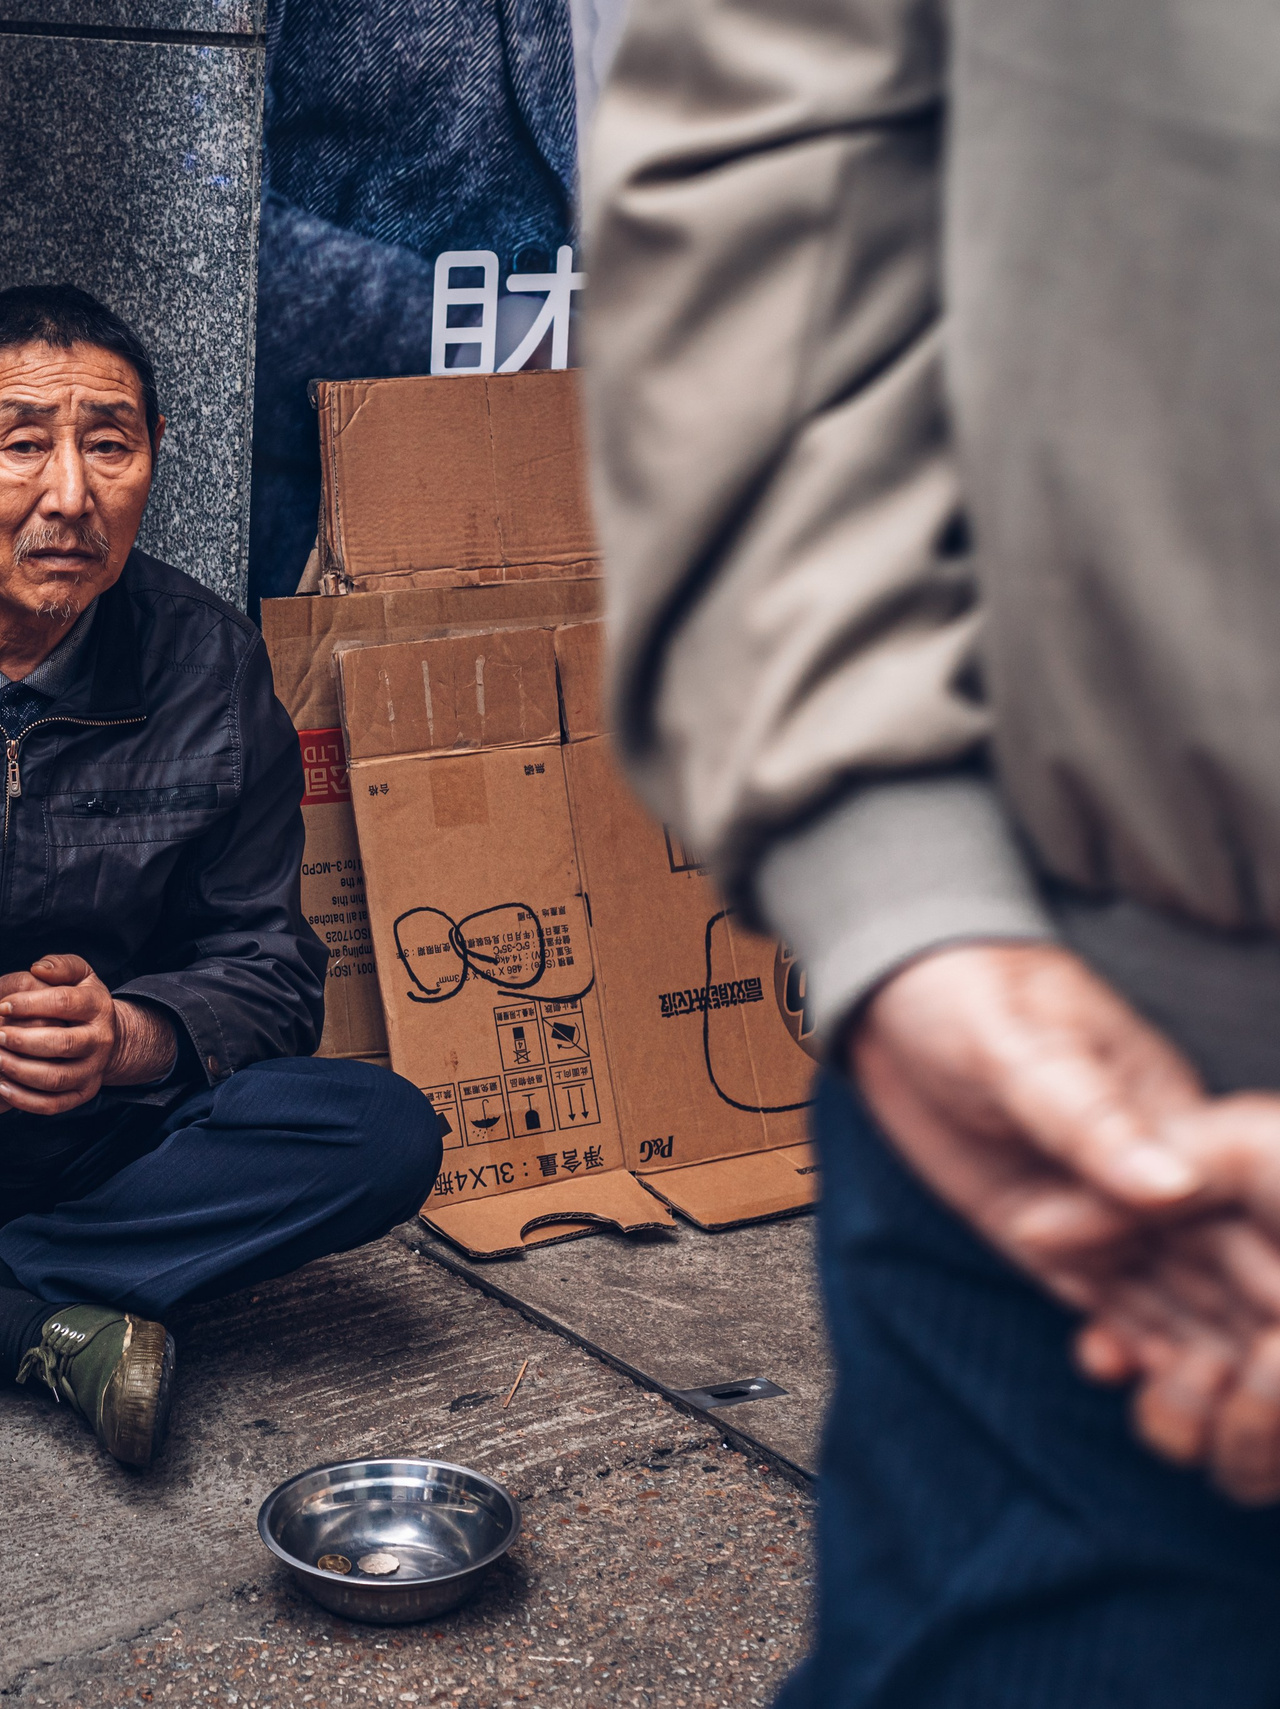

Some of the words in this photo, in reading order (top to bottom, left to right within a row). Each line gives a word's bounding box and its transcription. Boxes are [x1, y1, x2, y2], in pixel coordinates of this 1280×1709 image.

[304, 745, 339, 763] LTD
[368, 783, 389, 796] 合格
[344, 860, 356, 873] for
[341, 878, 354, 888] the
[332, 896, 348, 907] this
[309, 914, 344, 926] batches
[347, 913, 356, 923] all
[659, 977, 764, 1018] 高效能洗衣液
[639, 1135, 674, 1162] P&G
